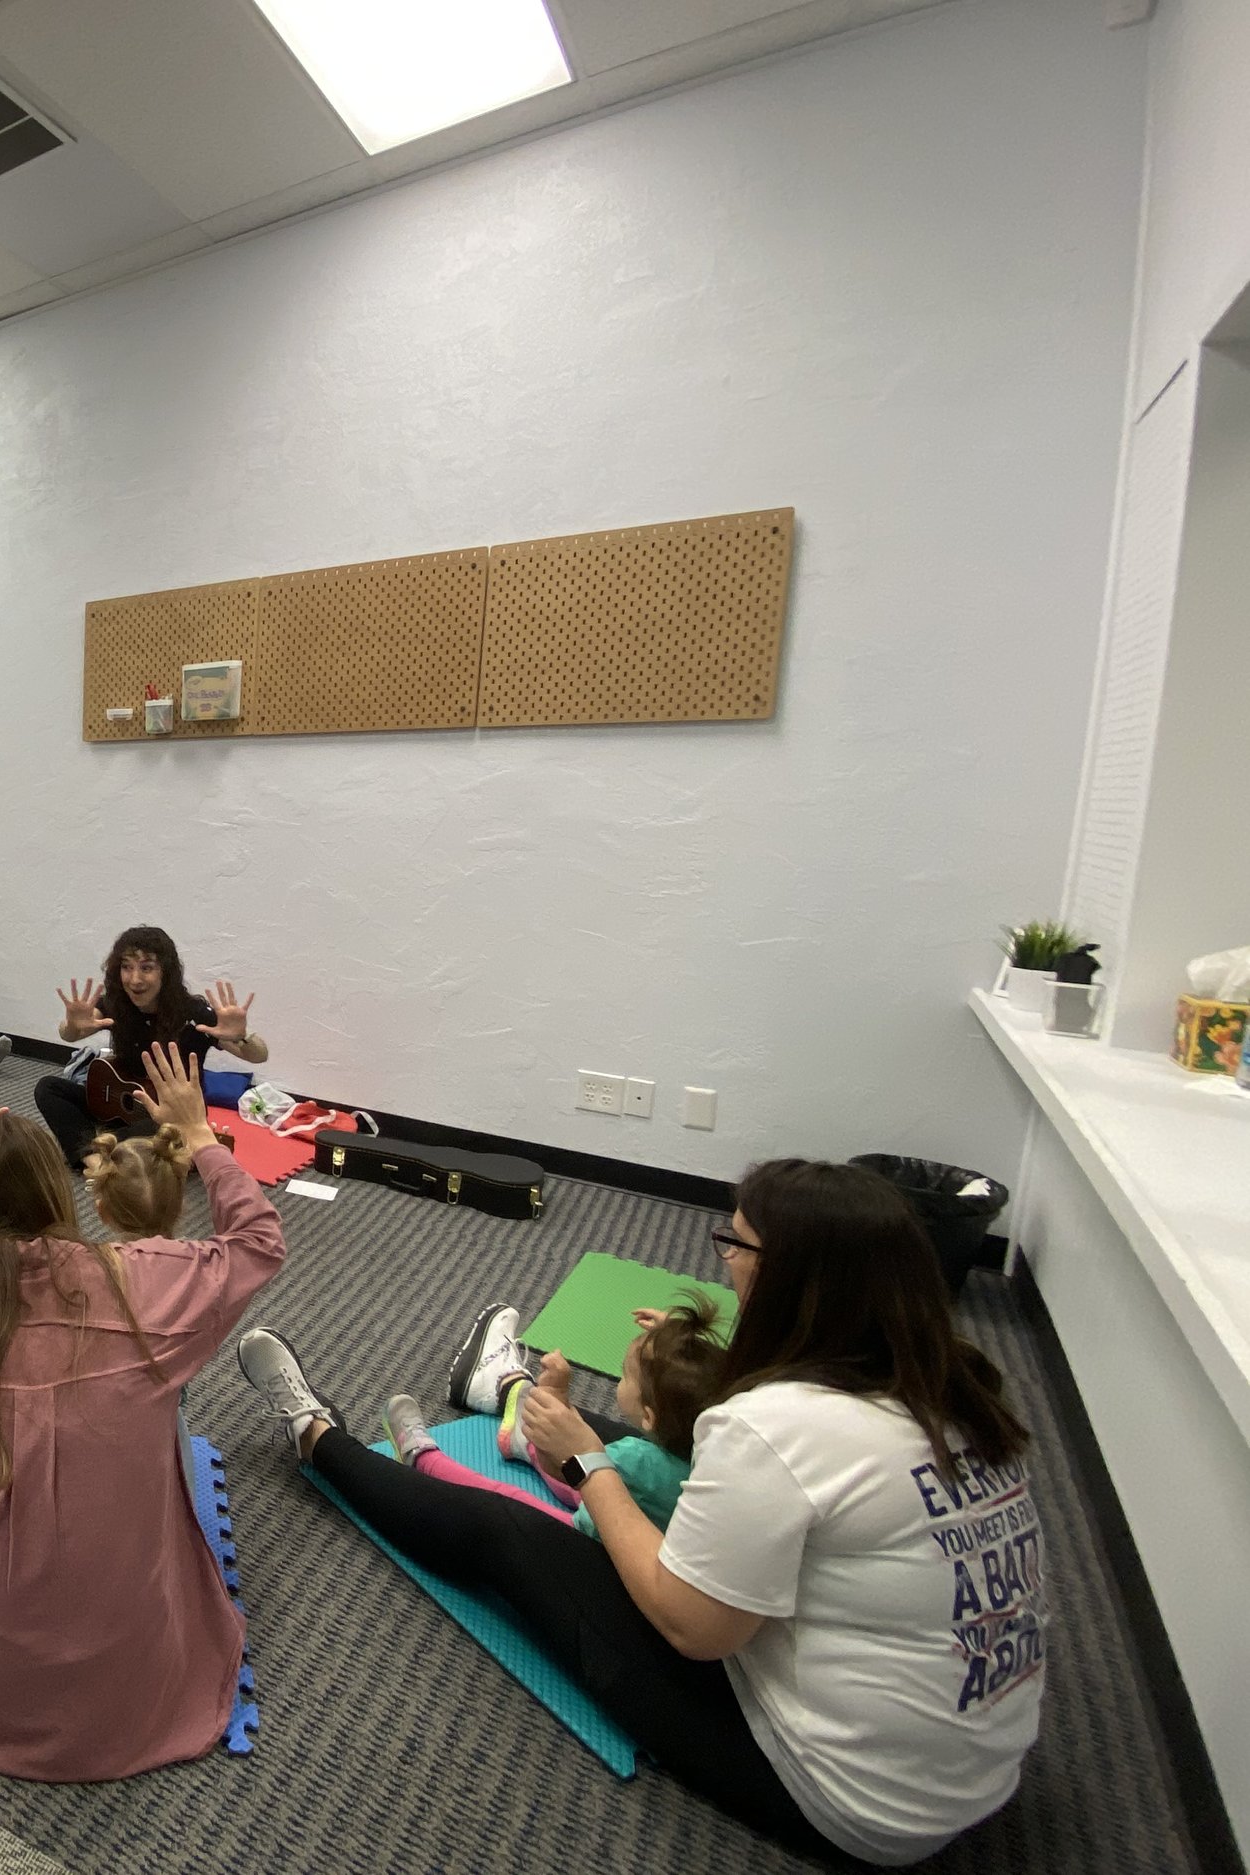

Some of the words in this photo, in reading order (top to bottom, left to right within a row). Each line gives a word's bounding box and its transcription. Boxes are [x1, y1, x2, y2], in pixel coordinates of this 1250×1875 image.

[932, 1523, 974, 1557] YOU
[972, 1511, 1007, 1548] MEET
[952, 1559, 983, 1621] A
